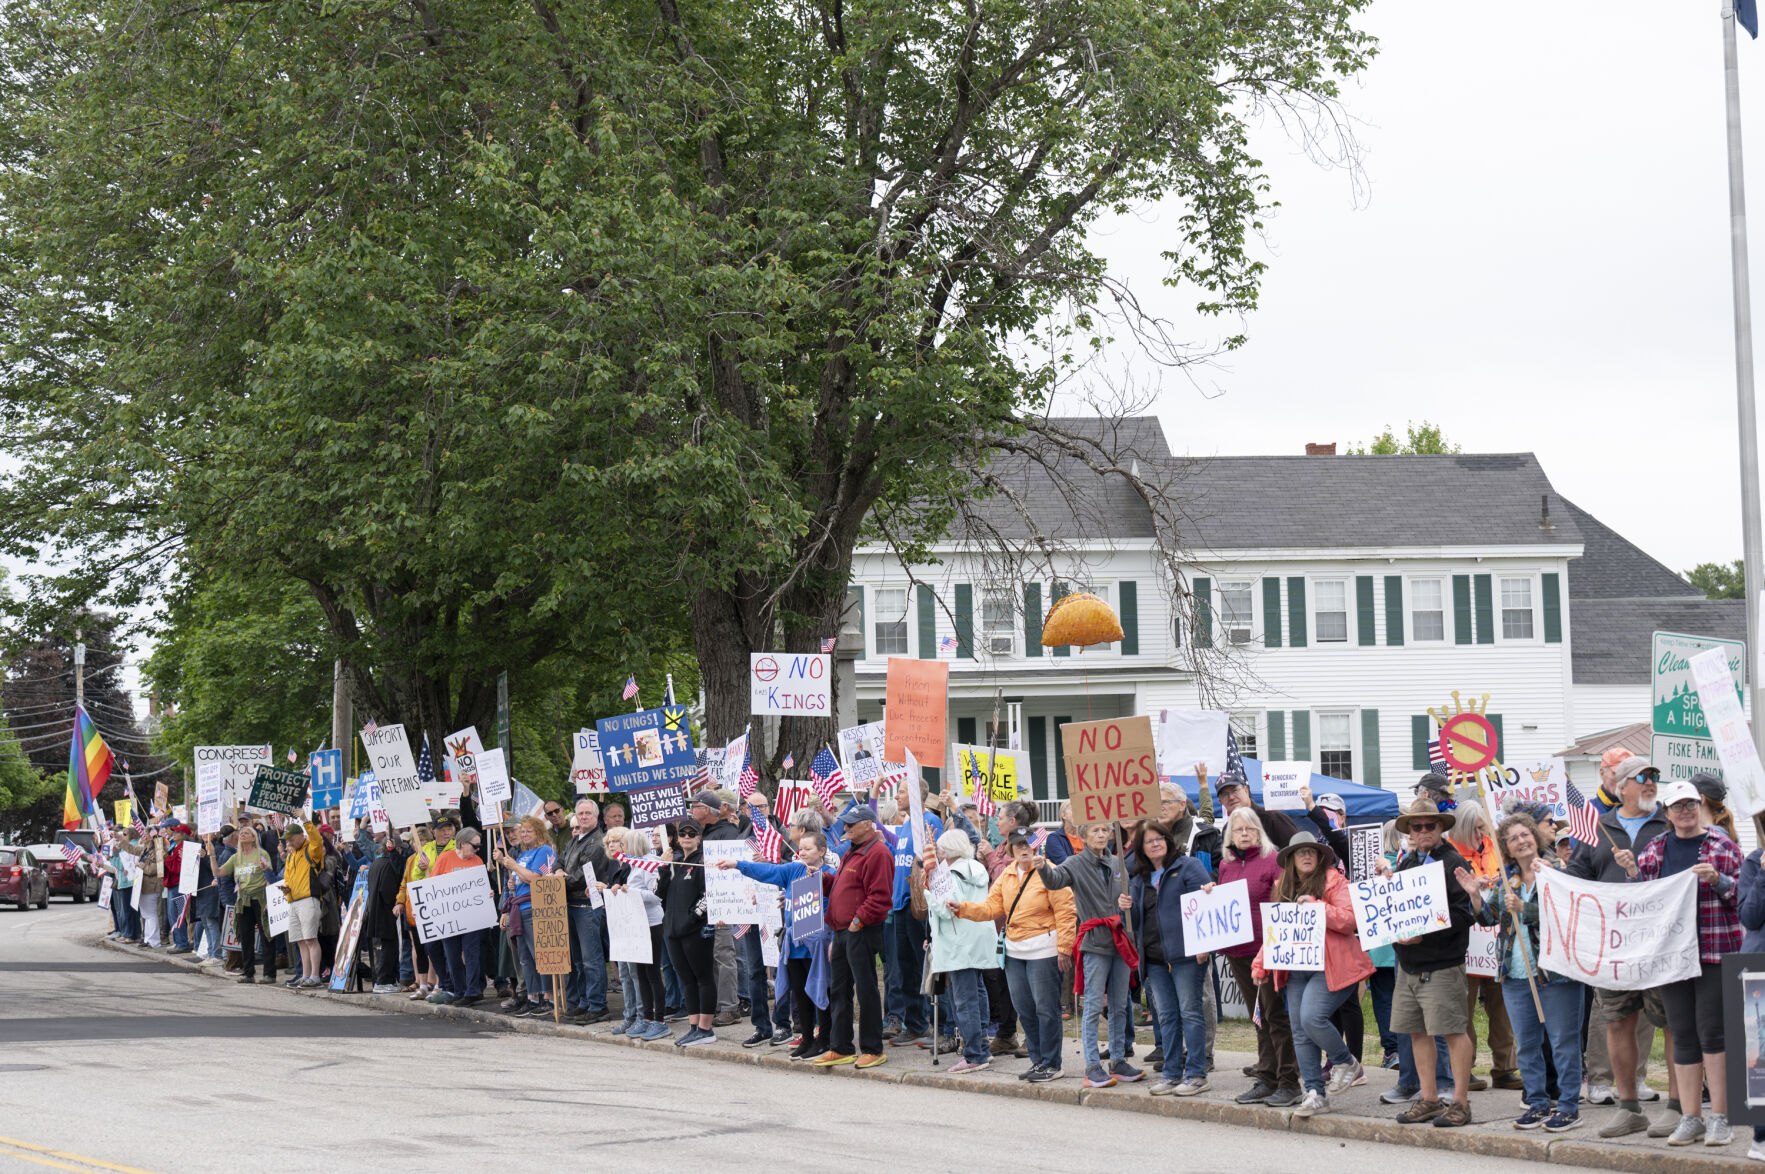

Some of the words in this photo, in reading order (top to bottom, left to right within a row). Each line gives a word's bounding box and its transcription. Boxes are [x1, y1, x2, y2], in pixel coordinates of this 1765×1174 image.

[789, 656, 823, 679] NO
[769, 686, 826, 710] KINGS
[1683, 695, 1702, 710] SP
[604, 719, 620, 733] NO
[623, 713, 660, 730] KINGS!
[889, 710, 904, 721] Due
[1667, 710, 1676, 725] A
[365, 726, 402, 747] SUPPORT
[580, 734, 599, 748] DE
[843, 726, 868, 741] RESIST
[1079, 724, 1122, 754] NO
[198, 748, 268, 760] CONGRESS
[1668, 742, 1692, 758] FISKE
[318, 755, 337, 786] H
[377, 754, 402, 769] OUR
[457, 755, 473, 769] NO
[851, 757, 877, 771] RESIST
[258, 766, 310, 788] PROTECT
[577, 768, 606, 780] CONST
[613, 771, 650, 787] UNITED
[652, 768, 668, 781] WE
[669, 764, 699, 779] STAND
[854, 767, 879, 783] RESIST
[965, 769, 1013, 789] POPLE
[1076, 755, 1155, 792] KINGS
[1486, 767, 1520, 792] NO
[261, 780, 275, 791] the
[276, 783, 301, 797] VOTE
[377, 775, 421, 795] VETERANS
[629, 791, 656, 804] HATE
[656, 786, 682, 799] WILL
[259, 789, 293, 805] PEOPLE
[631, 802, 653, 814] NOT
[655, 796, 684, 810] MAKE
[1085, 791, 1148, 821] EVER
[373, 808, 389, 824] FAS
[633, 813, 649, 824] US
[650, 806, 684, 821] GREAT
[717, 844, 727, 855] the
[412, 876, 486, 906] Inhumane
[535, 879, 562, 894] STAND
[1358, 872, 1404, 901] Stand
[1412, 875, 1427, 888] in
[418, 894, 485, 921] Callous
[543, 893, 558, 906] FOR
[799, 891, 814, 906] NO
[1365, 894, 1433, 923] Defiance
[531, 906, 567, 918] DEMOCRACY
[794, 900, 820, 923] KING
[1184, 898, 1198, 921] NO
[1271, 903, 1317, 926] Justice
[1616, 900, 1665, 920] KINGS
[422, 919, 467, 940] EVIL
[537, 920, 565, 935] STAND
[1195, 899, 1242, 941] KING
[1366, 923, 1378, 938] of
[1384, 909, 1433, 933] Tyranny!
[1544, 882, 1606, 976] NO
[536, 933, 568, 949] AGAINST
[1280, 927, 1288, 942] is
[1293, 926, 1314, 943] NOT
[1610, 917, 1685, 949] DICTATORS
[535, 950, 571, 966] FASCISM
[1272, 945, 1295, 966] Just
[1609, 948, 1693, 981] TYRANTS
